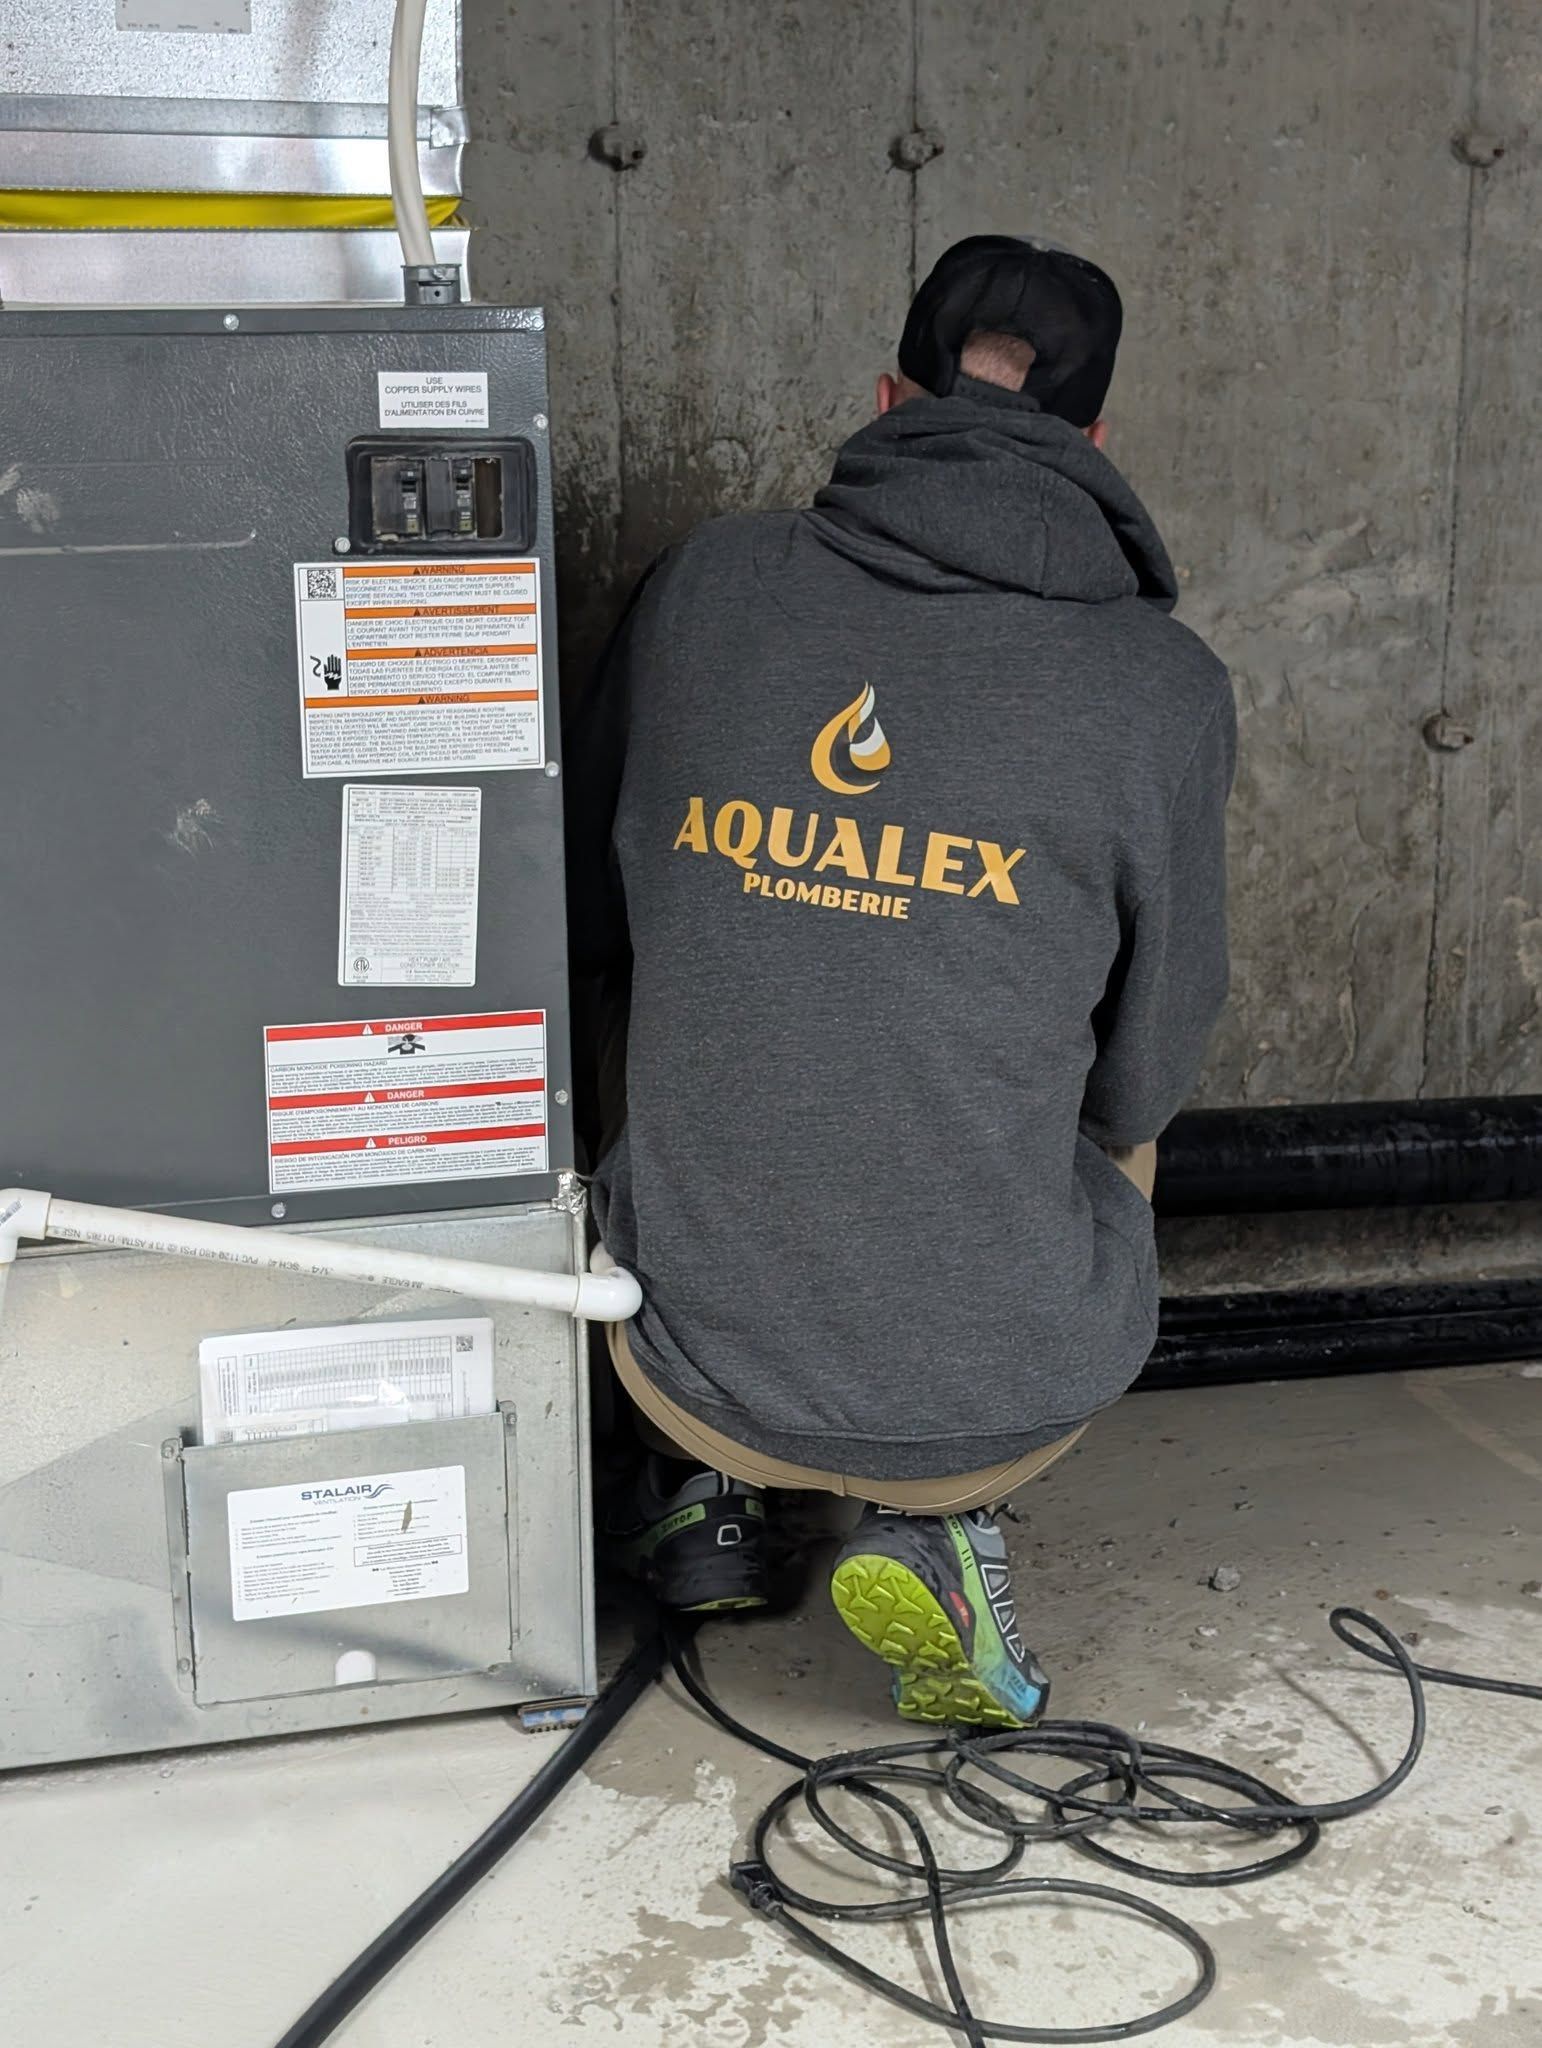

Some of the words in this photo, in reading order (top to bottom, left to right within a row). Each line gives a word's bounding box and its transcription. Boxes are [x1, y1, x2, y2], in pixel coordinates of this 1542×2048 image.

[384, 385, 419, 393] COPPER
[421, 385, 453, 393] SUPPLY
[454, 385, 481, 393] WIRES
[421, 565, 464, 573] WARNING
[422, 605, 499, 615] AVERTISSEMENT
[424, 647, 487, 655] ADVERTENCIA
[426, 695, 469, 703] WARNING
[673, 797, 1026, 905] AQUALEX
[743, 872, 911, 920] PLOMBERIE
[385, 1022, 422, 1031] DANGER
[387, 1090, 424, 1099] DANGER
[388, 1135, 426, 1145] PELIGRO
[180, 1246, 197, 1256] PSI
[242, 1255, 259, 1266] PVC
[382, 1276, 410, 1288] EAGLE
[301, 1484, 371, 1500] STALAIR
[313, 1495, 360, 1505] VENTILATION
